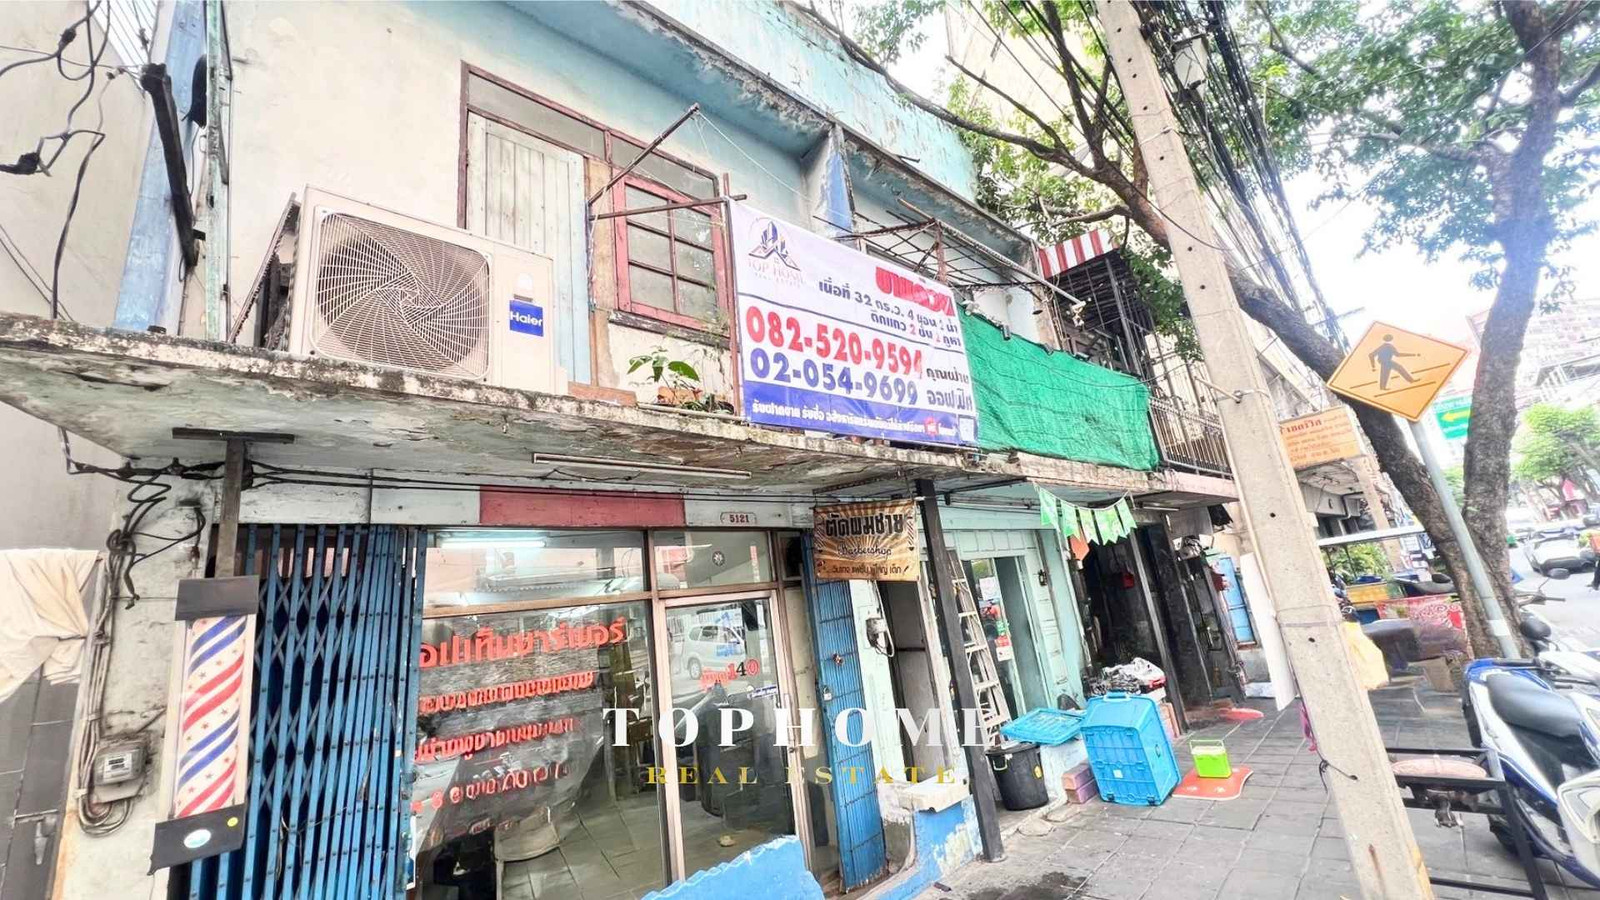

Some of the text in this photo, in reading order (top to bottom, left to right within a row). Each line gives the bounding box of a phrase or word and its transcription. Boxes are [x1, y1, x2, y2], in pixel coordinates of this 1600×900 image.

[855, 291, 872, 307] 32
[510, 311, 542, 327] Haier
[746, 305, 922, 380] 082-520-9594
[751, 347, 918, 406] 02-054-9699
[730, 514, 750, 523] 5121
[826, 513, 904, 537] ตัดผมชาย
